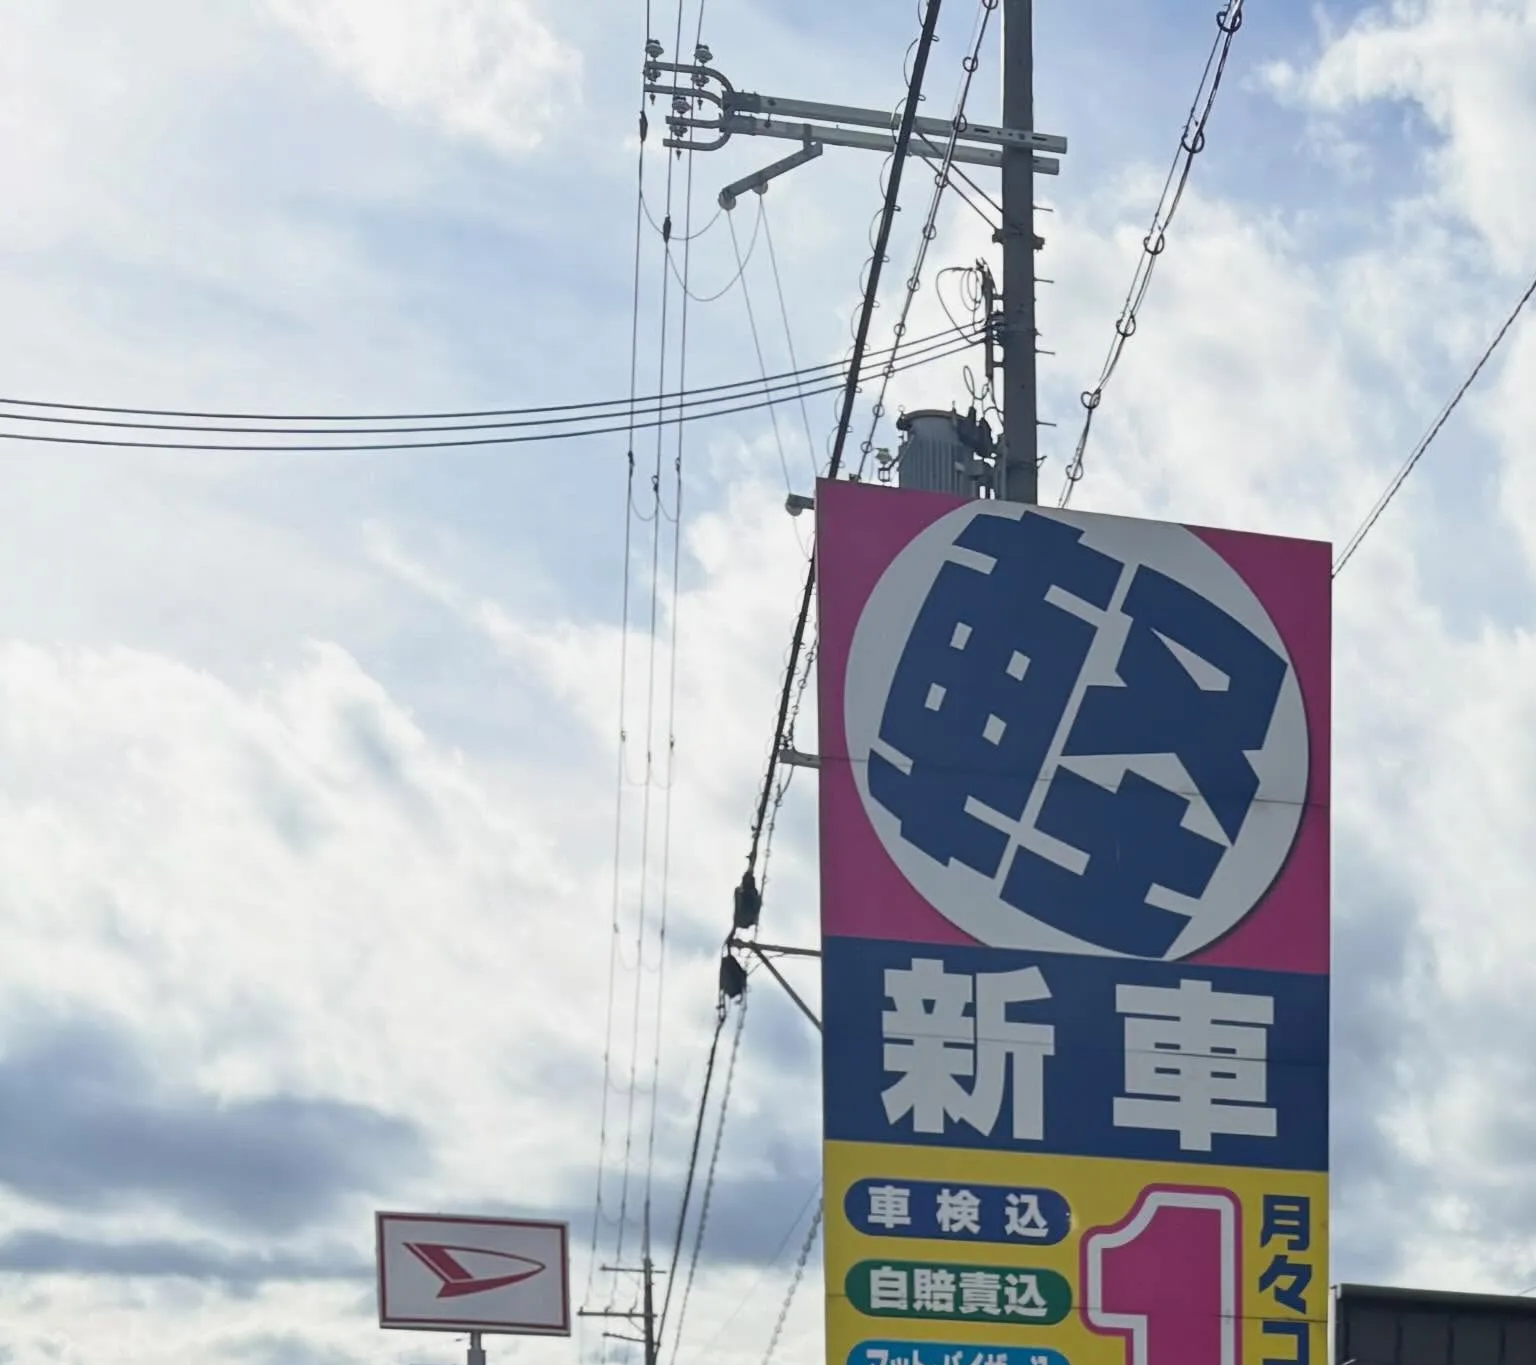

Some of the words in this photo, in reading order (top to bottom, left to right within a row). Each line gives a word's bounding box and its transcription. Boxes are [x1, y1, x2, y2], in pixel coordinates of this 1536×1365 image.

[867, 510, 1289, 960] 軽
[880, 957, 1279, 1152] 新車
[866, 1185, 1050, 1239] 車検込
[868, 1265, 1049, 1318] 自賠責込
